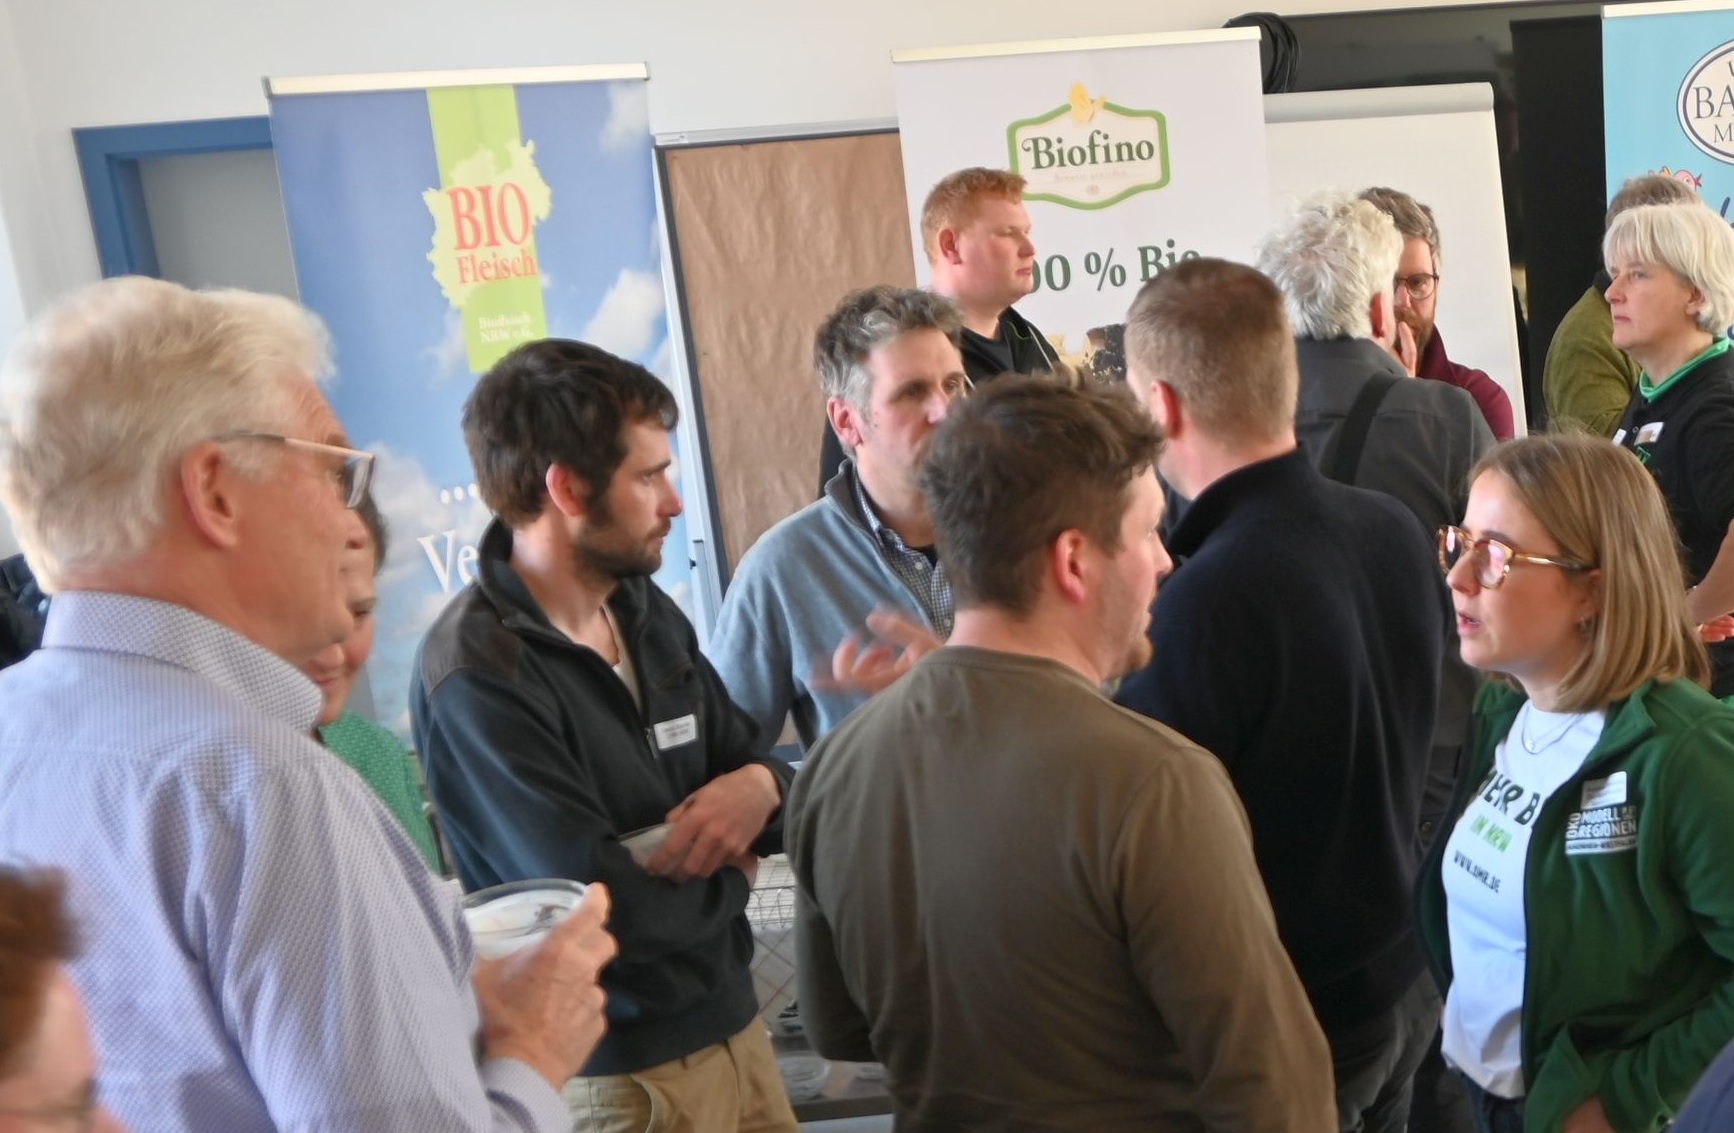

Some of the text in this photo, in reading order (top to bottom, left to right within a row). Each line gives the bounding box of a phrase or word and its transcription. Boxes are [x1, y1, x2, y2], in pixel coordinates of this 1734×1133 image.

[1022, 129, 1155, 171] Biofino
[446, 181, 532, 251] BIO
[456, 249, 538, 285] Fleisch
[1083, 247, 1127, 292] %
[1578, 819, 1638, 838] REGIONEN
